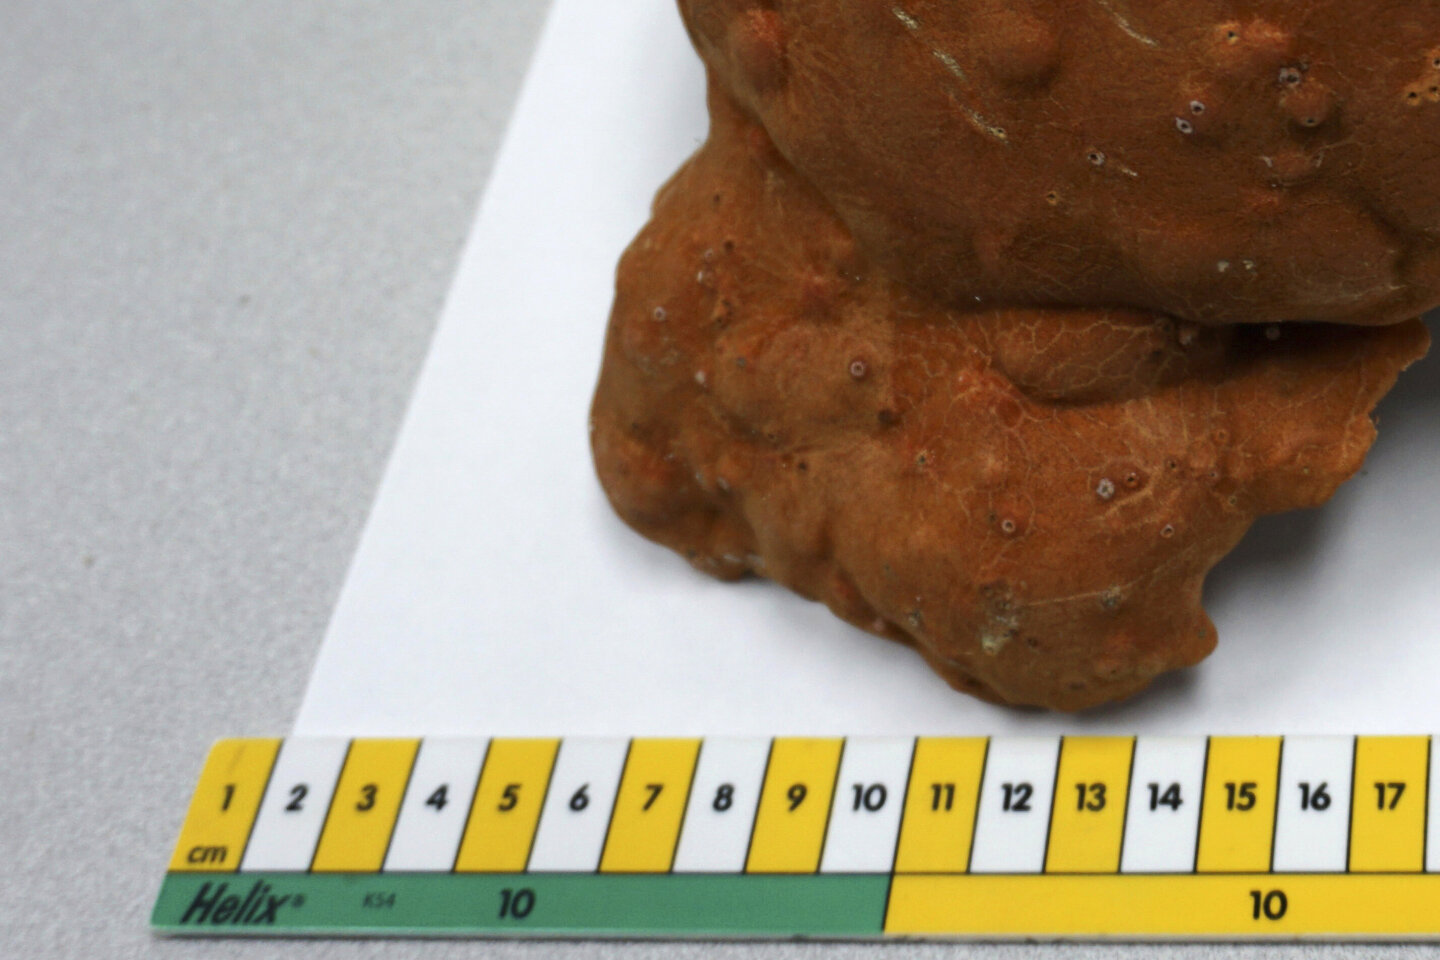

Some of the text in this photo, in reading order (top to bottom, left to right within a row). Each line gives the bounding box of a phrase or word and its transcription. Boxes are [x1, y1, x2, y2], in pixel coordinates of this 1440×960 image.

[219, 783, 235, 813] 1
[285, 783, 308, 813] 2
[356, 783, 378, 813] 3
[425, 782, 448, 813] 4
[498, 782, 520, 812] 5
[568, 782, 590, 812] 6
[641, 782, 664, 812] 7
[712, 782, 735, 812] 8
[786, 782, 808, 812] 9
[853, 781, 888, 812] 10
[931, 781, 956, 812] 11
[1001, 781, 1034, 811] 12
[1075, 781, 1107, 811] 13
[1149, 781, 1183, 811] 14
[1224, 781, 1257, 811] 15
[1298, 780, 1332, 811] 16
[1374, 780, 1407, 811] 17
[187, 843, 228, 865] cm
[497, 887, 537, 922] 10
[1250, 889, 1289, 921] 10
